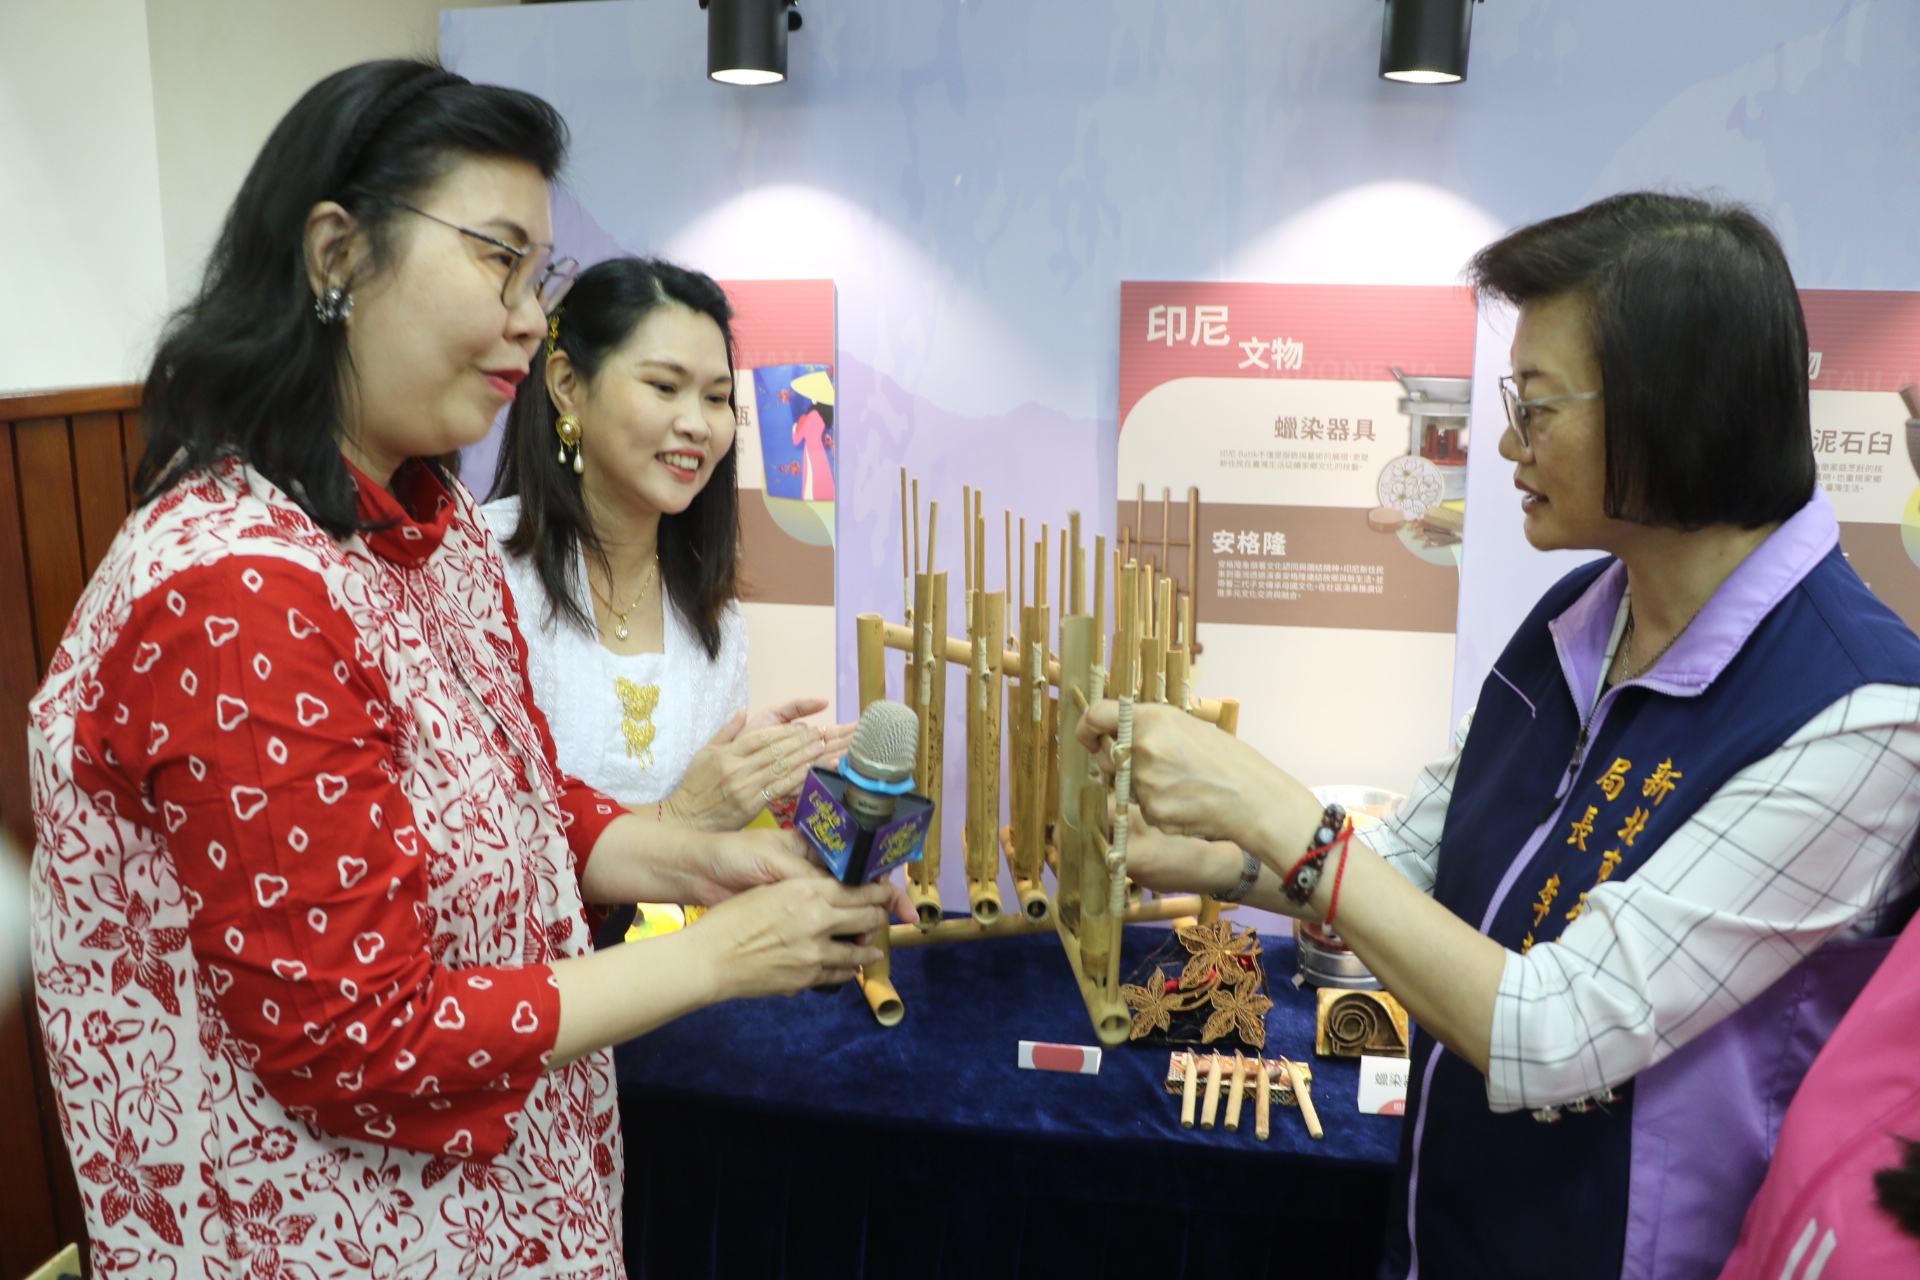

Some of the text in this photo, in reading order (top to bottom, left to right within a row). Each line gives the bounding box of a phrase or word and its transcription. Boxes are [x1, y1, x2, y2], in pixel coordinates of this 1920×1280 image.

[1146, 304, 1304, 371] 印尼 文物
[1274, 415, 1376, 442] 蠟染器具
[1812, 428, 1893, 456] 泥石臼
[1212, 530, 1286, 556] 安格隆
